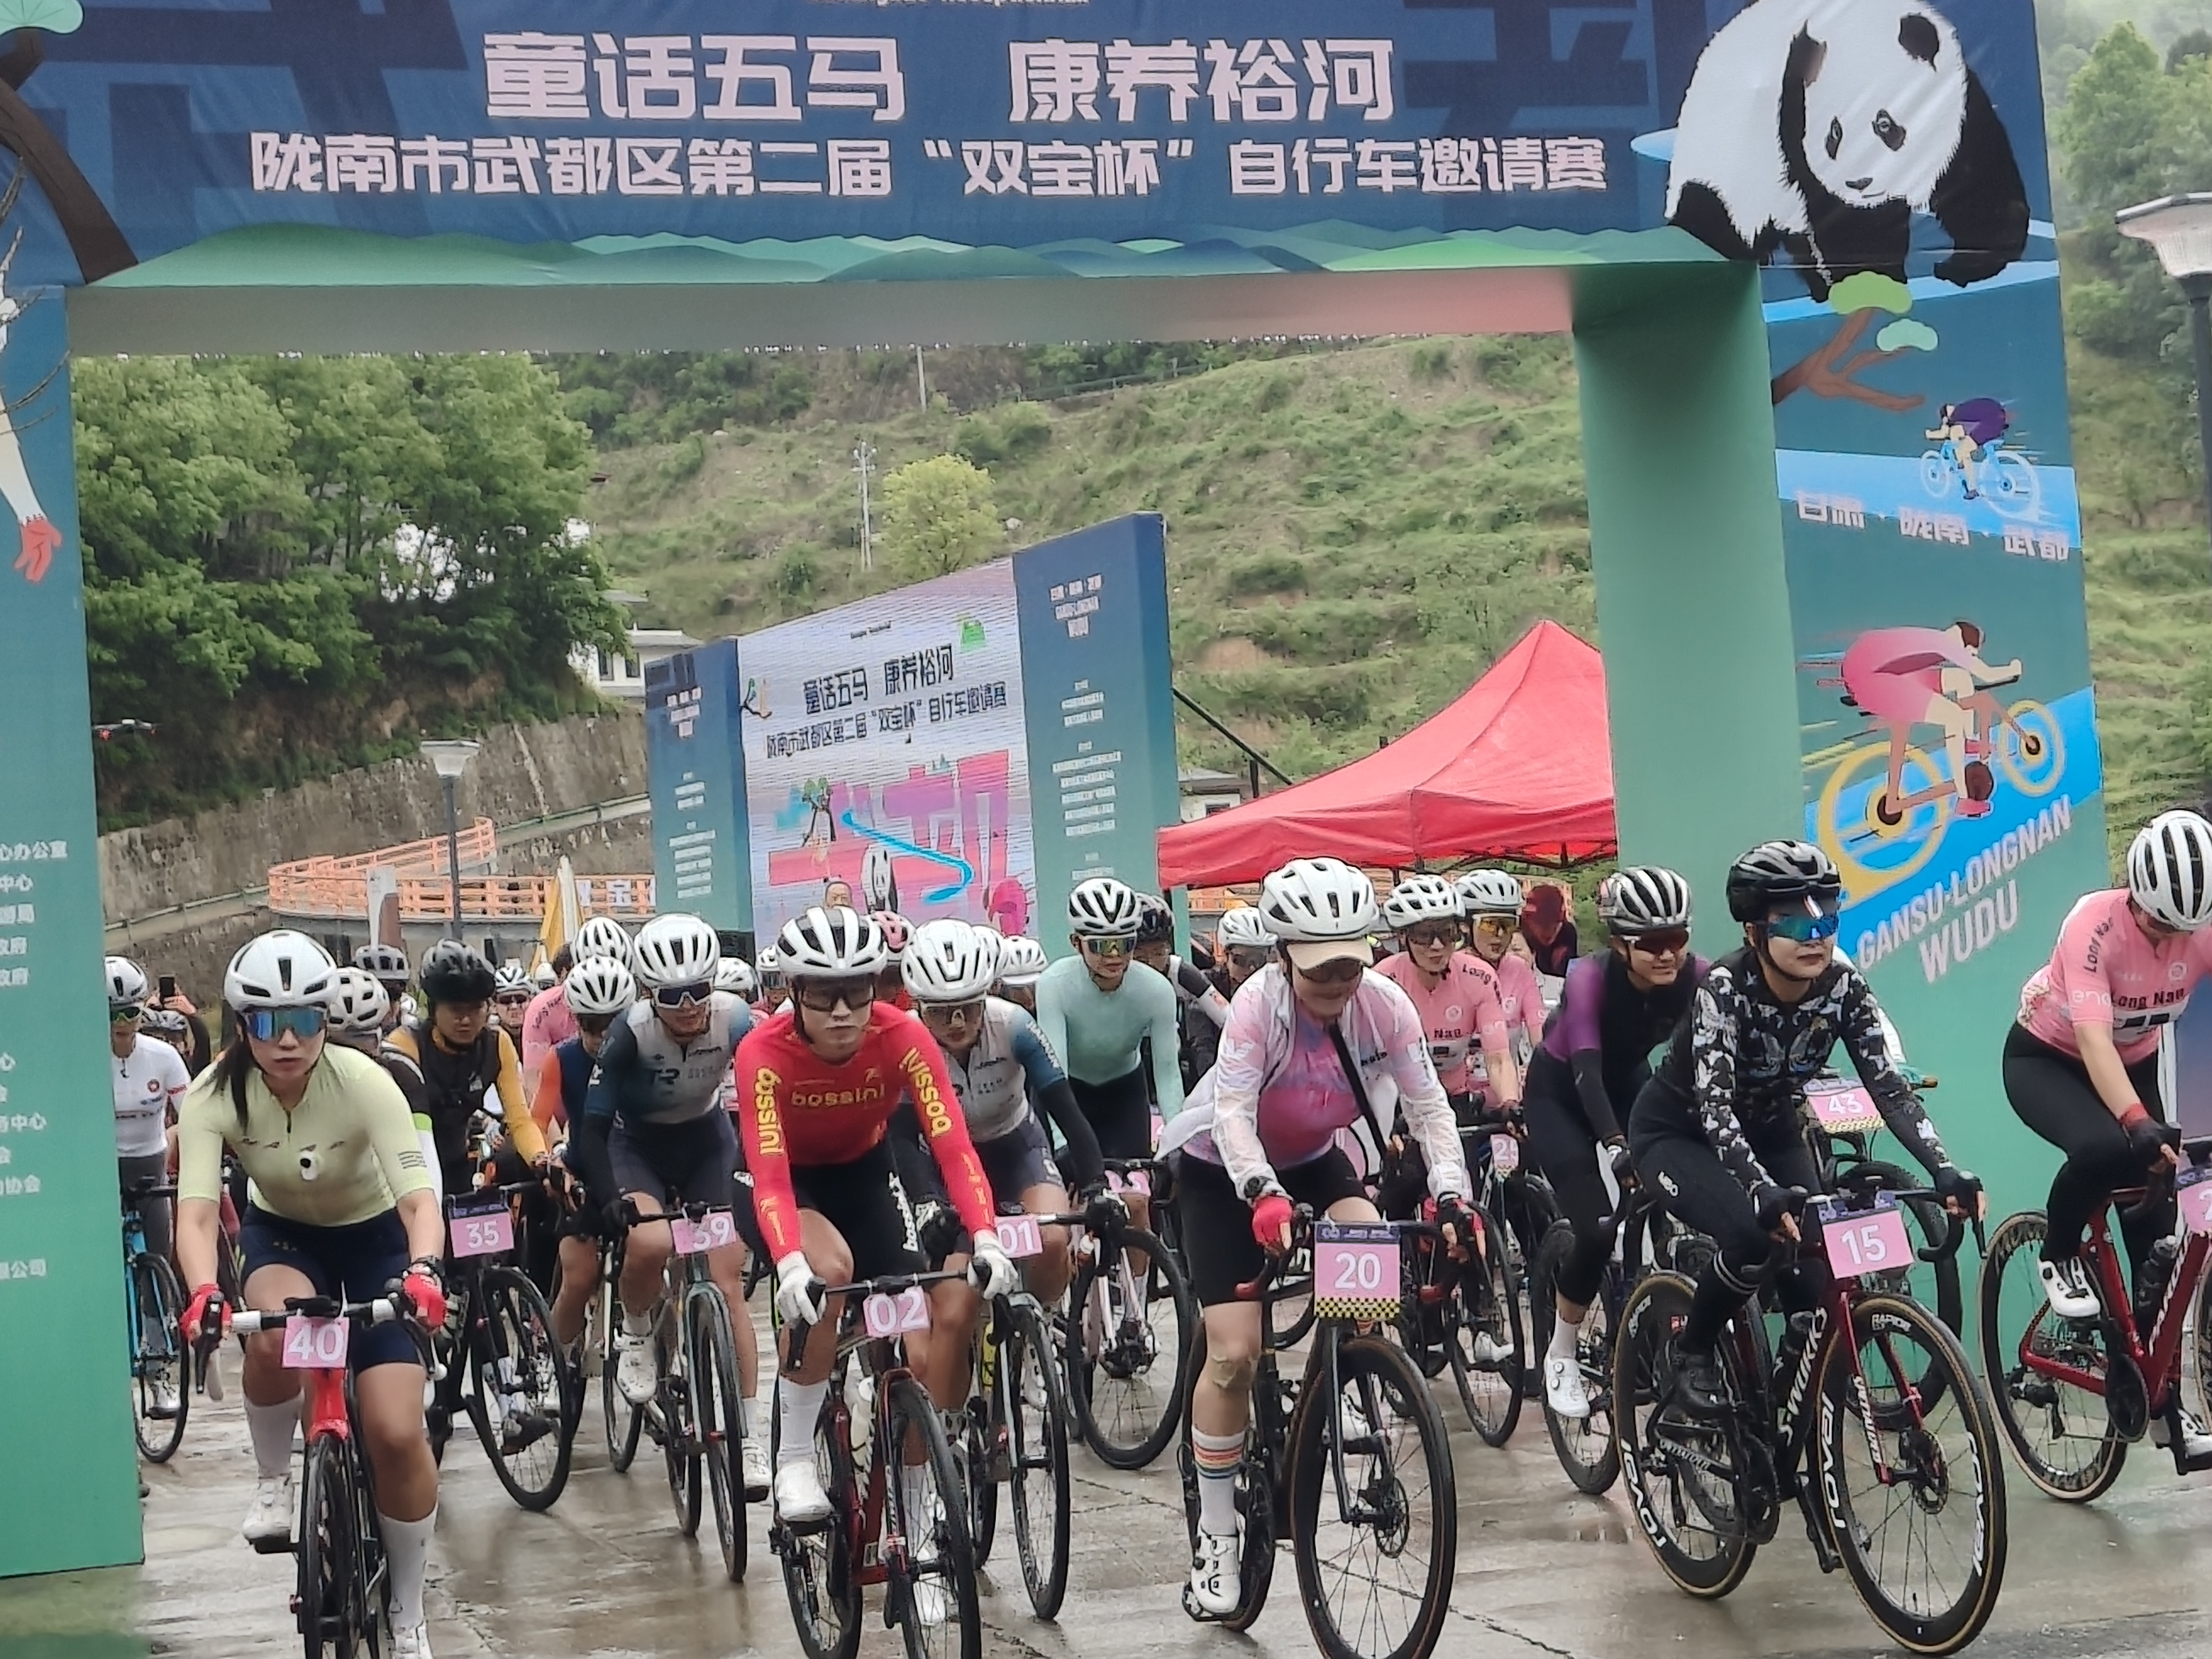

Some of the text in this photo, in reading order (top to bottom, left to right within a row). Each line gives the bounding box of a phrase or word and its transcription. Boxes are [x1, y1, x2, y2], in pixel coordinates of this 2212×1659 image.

[482, 31, 1395, 123] 童话五马 康养裕河
[1918, 879, 2020, 986] WUDU
[754, 1067, 785, 1156] bossini
[791, 1083, 886, 1107] bossini
[1827, 1087, 1865, 1114] 43
[466, 1220, 500, 1248] 35
[997, 1220, 1036, 1255] 01
[1839, 1224, 1887, 1266] 15
[1334, 1251, 1382, 1291] 20
[867, 1290, 925, 1334] 02
[287, 1327, 345, 1362] 40
